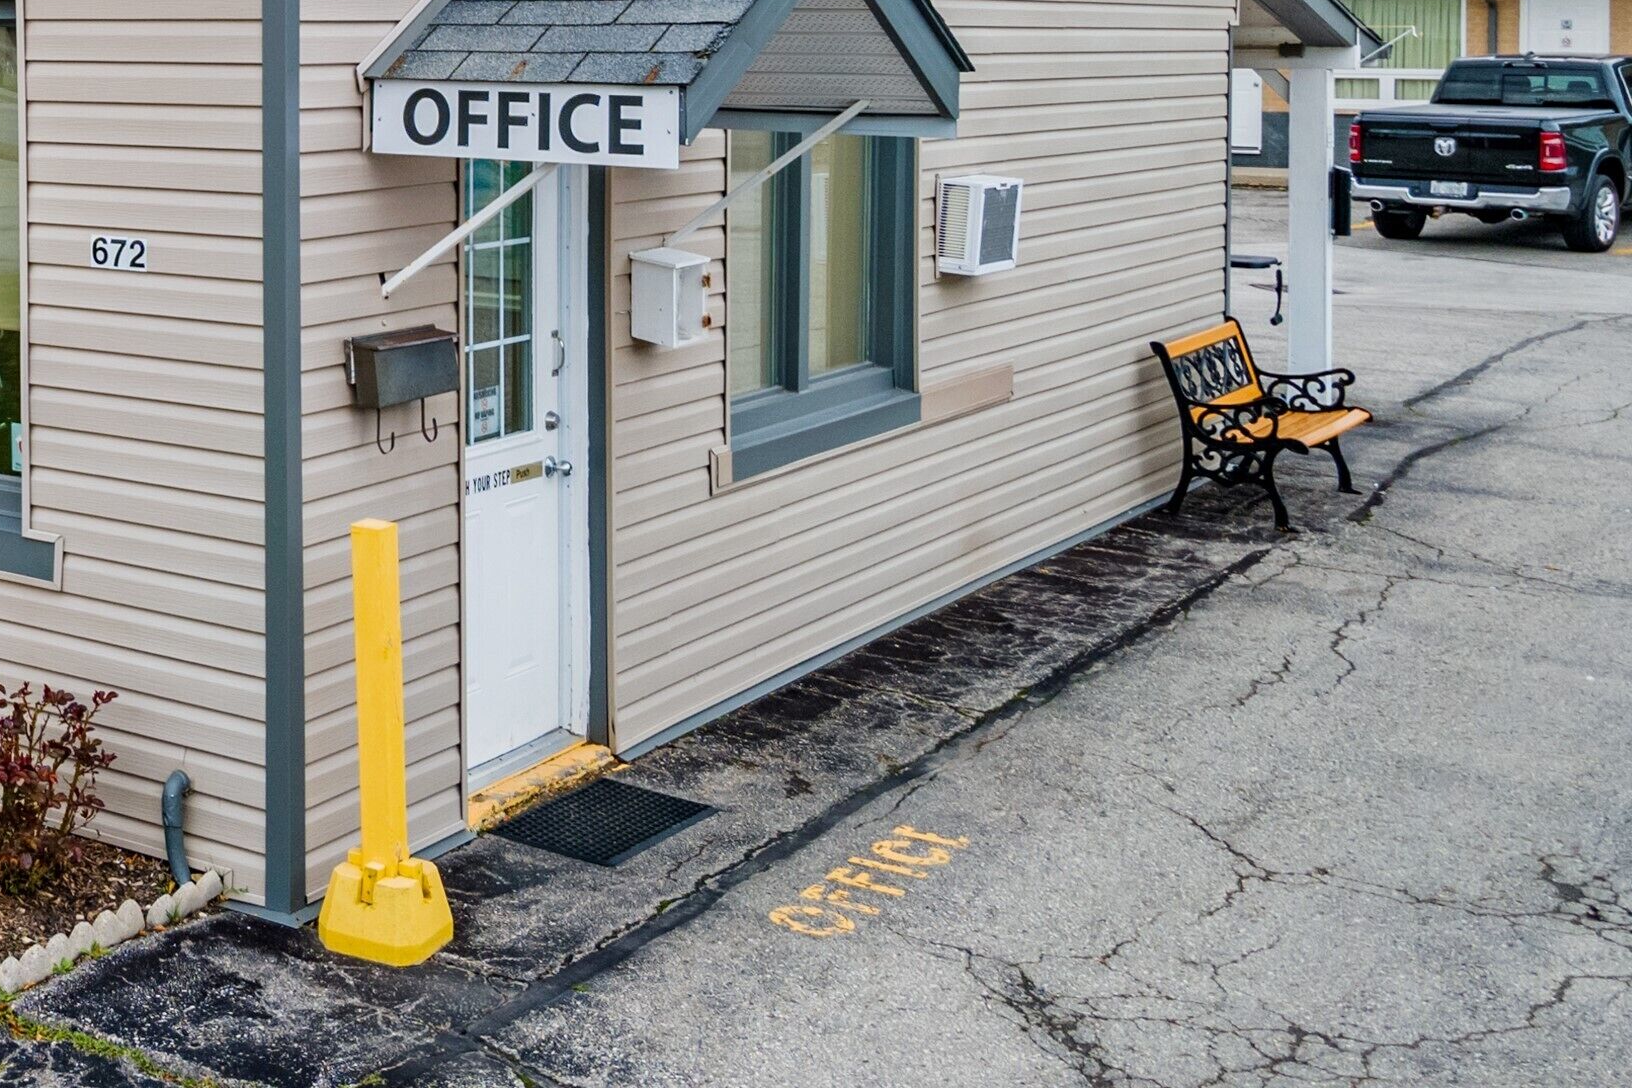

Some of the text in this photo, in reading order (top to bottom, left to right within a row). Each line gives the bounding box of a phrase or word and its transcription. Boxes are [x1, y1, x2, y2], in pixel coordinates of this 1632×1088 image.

[402, 87, 645, 156] OFFICE
[92, 236, 146, 269] 672
[472, 475, 491, 494] YOUR
[493, 469, 511, 489] STEP
